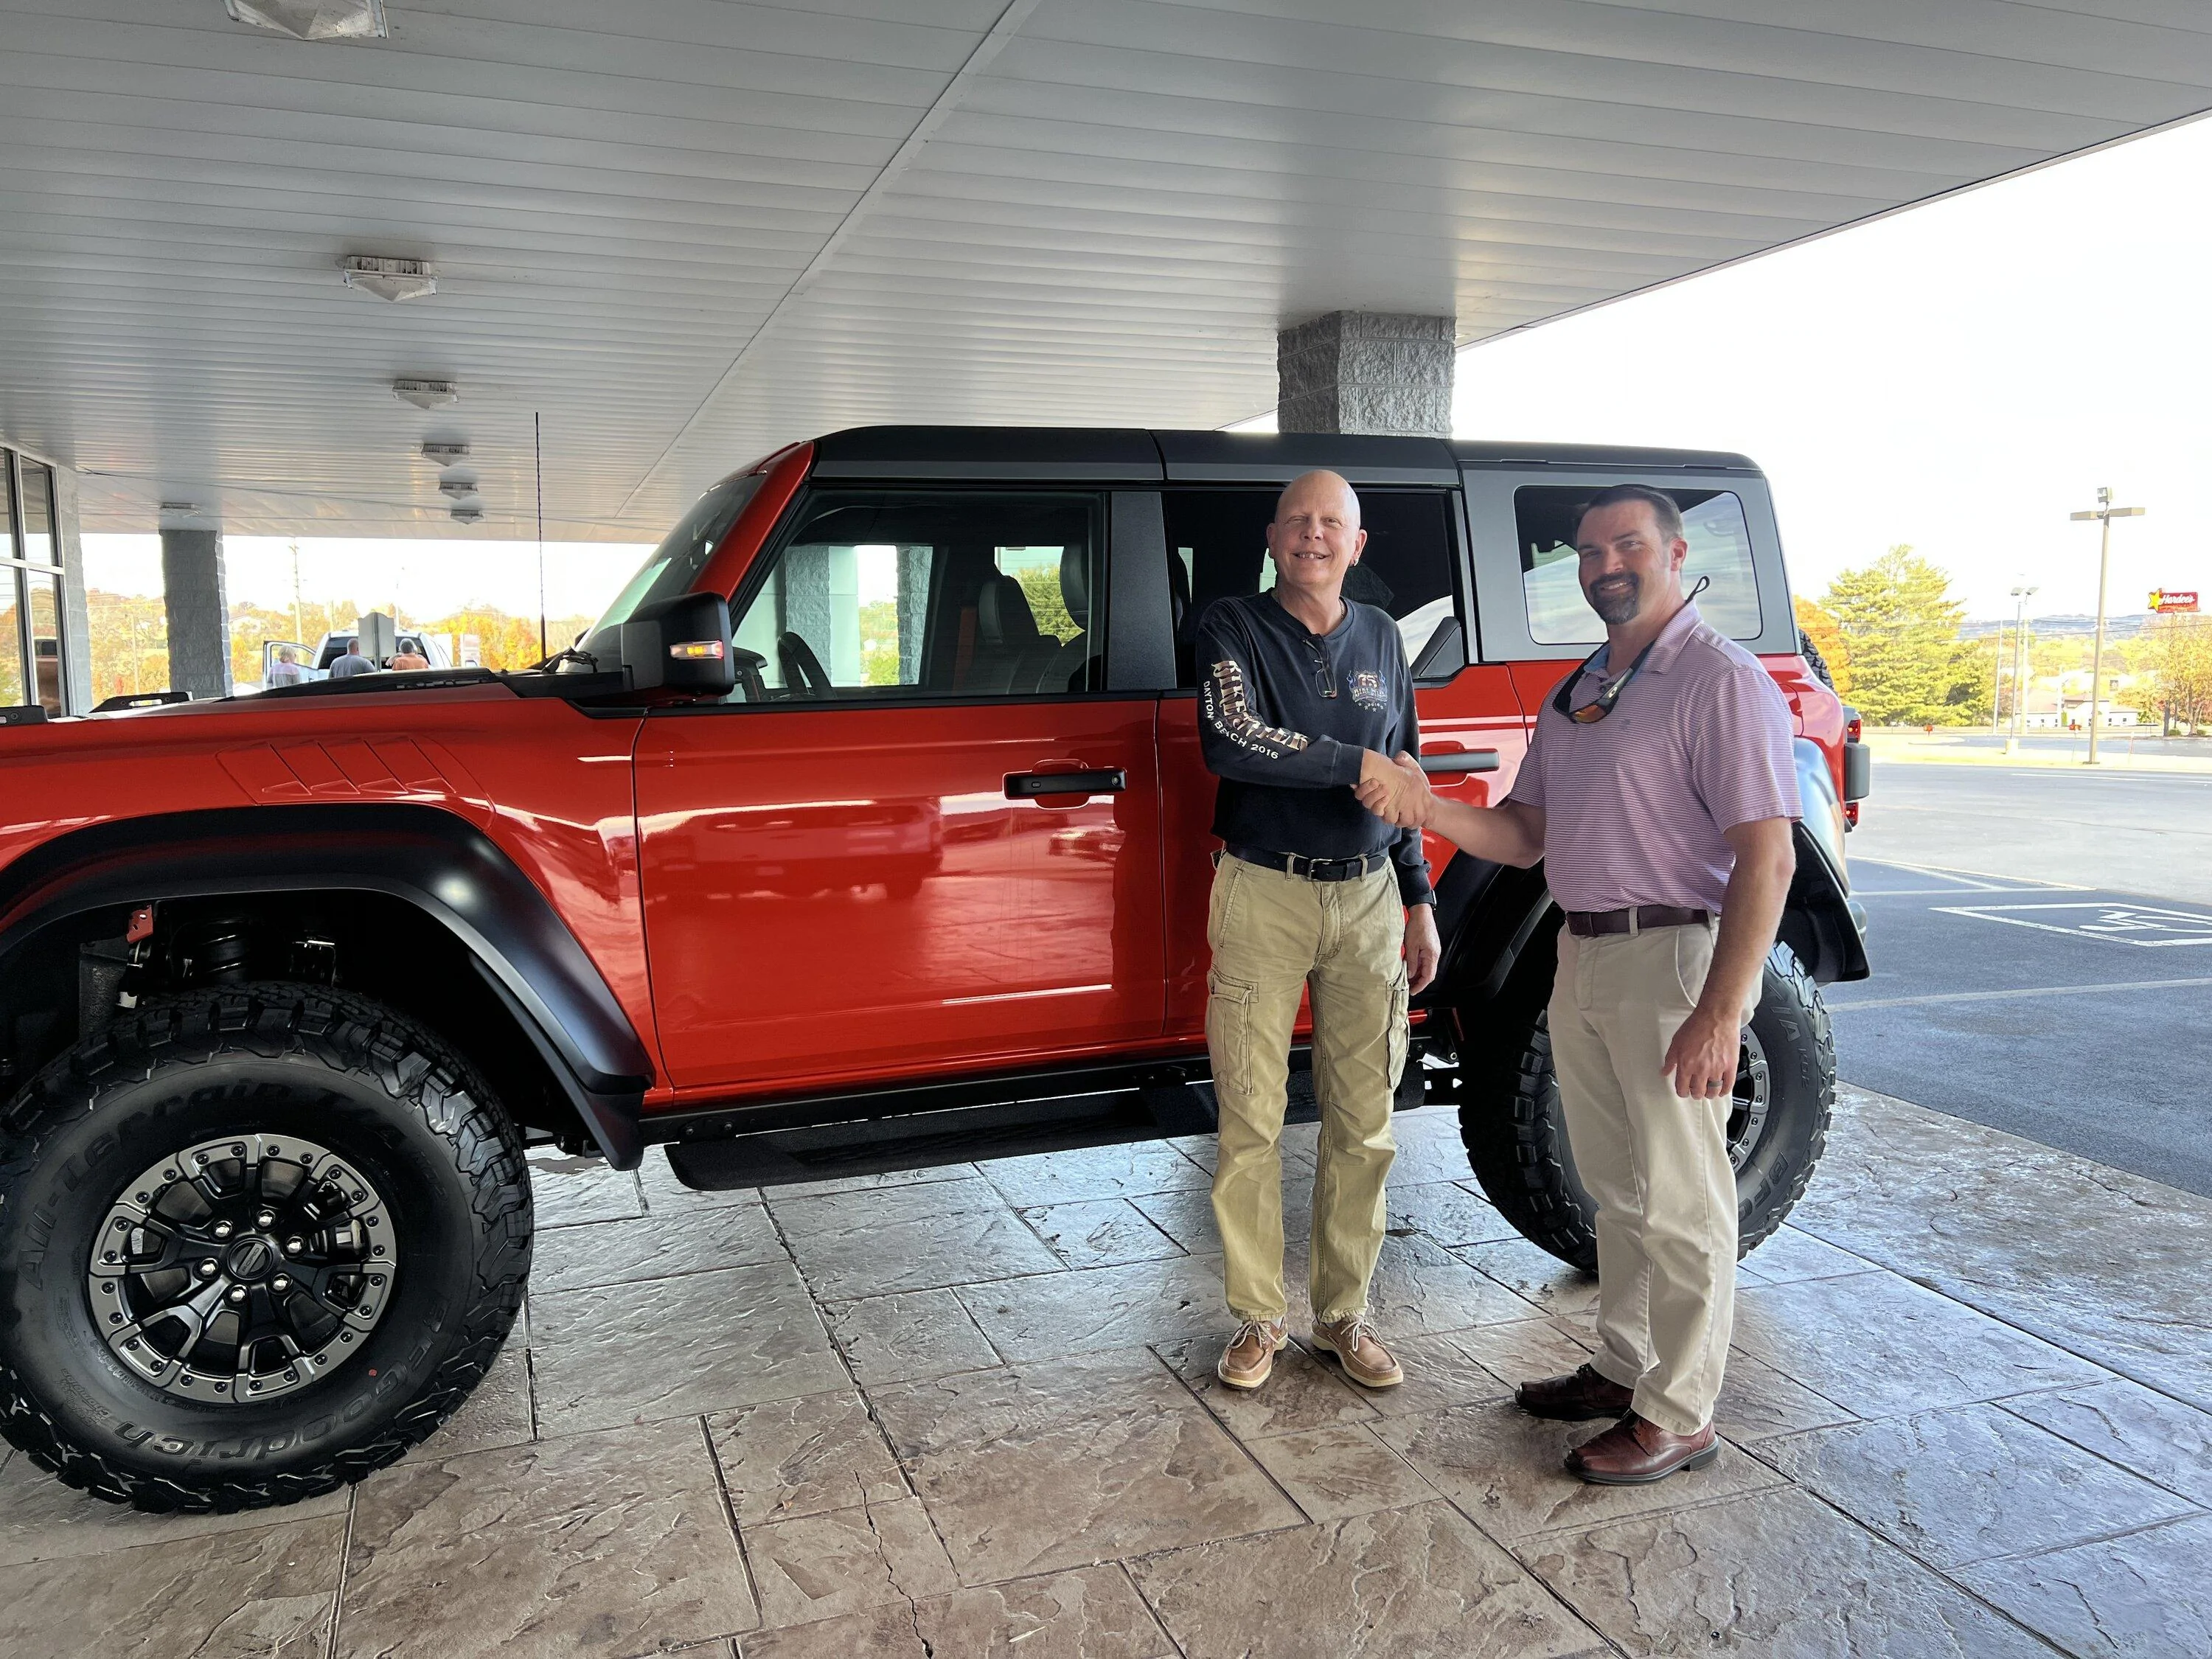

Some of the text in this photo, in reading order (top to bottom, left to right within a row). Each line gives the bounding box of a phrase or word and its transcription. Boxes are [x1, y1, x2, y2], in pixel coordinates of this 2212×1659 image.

[1203, 680, 1279, 759] DAYTON BEACH 2016
[1211, 660, 1247, 717] BIKE
[17, 1083, 293, 1290] All-Terrain
[113, 1304, 451, 1466] BFGoodrich
